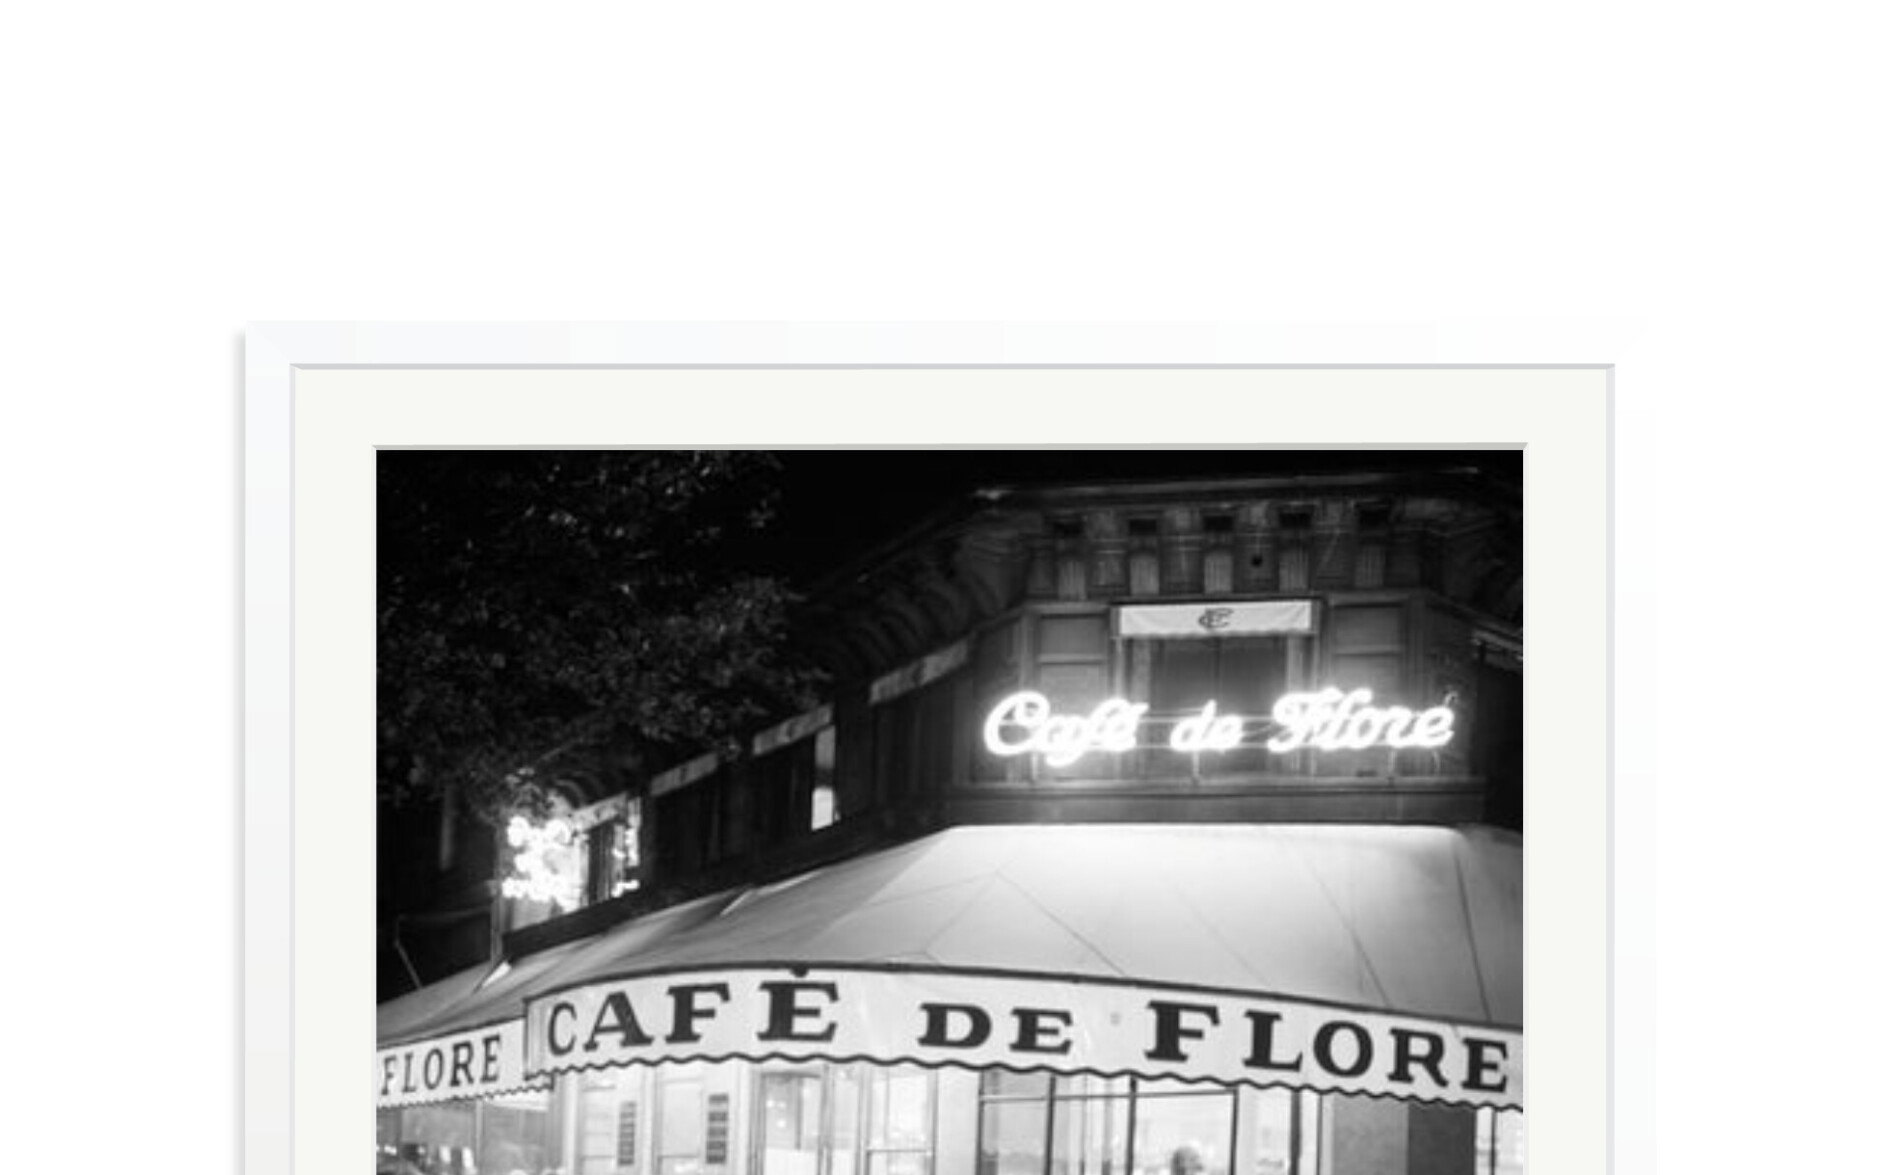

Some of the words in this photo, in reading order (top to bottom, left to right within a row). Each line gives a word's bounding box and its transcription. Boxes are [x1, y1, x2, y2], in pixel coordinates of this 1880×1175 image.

[1169, 700, 1243, 751] de
[1267, 687, 1454, 753] Flore
[380, 1034, 502, 1096] FLORE
[917, 1002, 1075, 1055] DE
[1144, 999, 1510, 1093] FLORE
